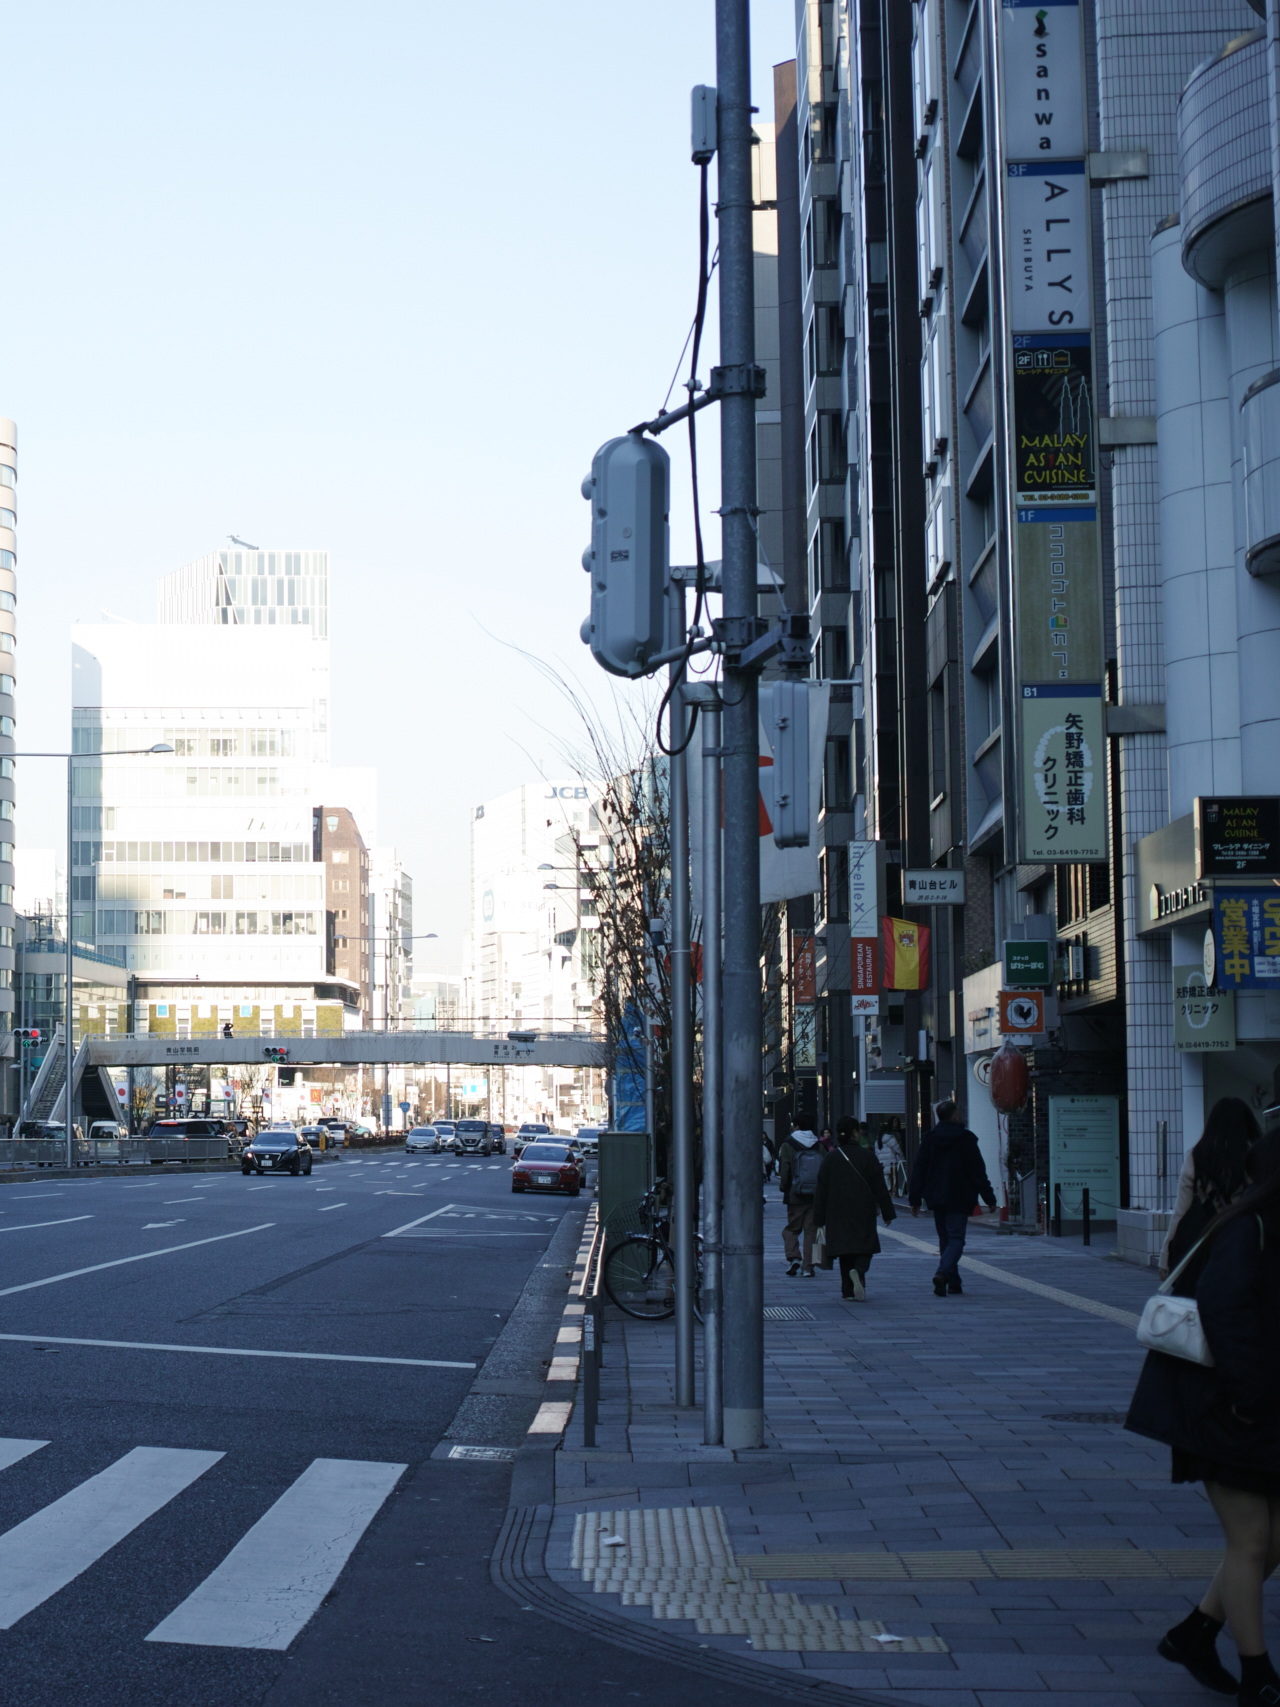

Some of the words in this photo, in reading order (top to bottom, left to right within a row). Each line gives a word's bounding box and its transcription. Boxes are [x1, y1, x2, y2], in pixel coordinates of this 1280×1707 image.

[1034, 43, 1053, 150] sanwa
[1009, 165, 1027, 177] 3F
[1045, 180, 1074, 326] ALLYS
[1023, 229, 1033, 292] SHIBUYA
[1014, 336, 1031, 348] 2F
[1018, 356, 1031, 365] 2F
[1021, 434, 1088, 448] MALAY
[1024, 469, 1087, 484] CUISINE
[1020, 511, 1035, 522] 1F
[1023, 687, 1038, 697] B1
[1065, 713, 1087, 826] 矢野矯正歯科
[544, 786, 588, 799] JCB
[1043, 756, 1061, 841] クリニック
[1223, 807, 1260, 816] MALAY
[1224, 829, 1259, 838] CUISINE
[1046, 848, 1100, 856] 03-6419-7752
[1212, 843, 1241, 851] マレーシア
[1236, 860, 1247, 869] 2F
[908, 879, 958, 891] 青山台ビル
[1220, 898, 1251, 983] 営業中
[1181, 1003, 1219, 1015] クリニック
[1185, 1040, 1230, 1049] 03-6419-7752
